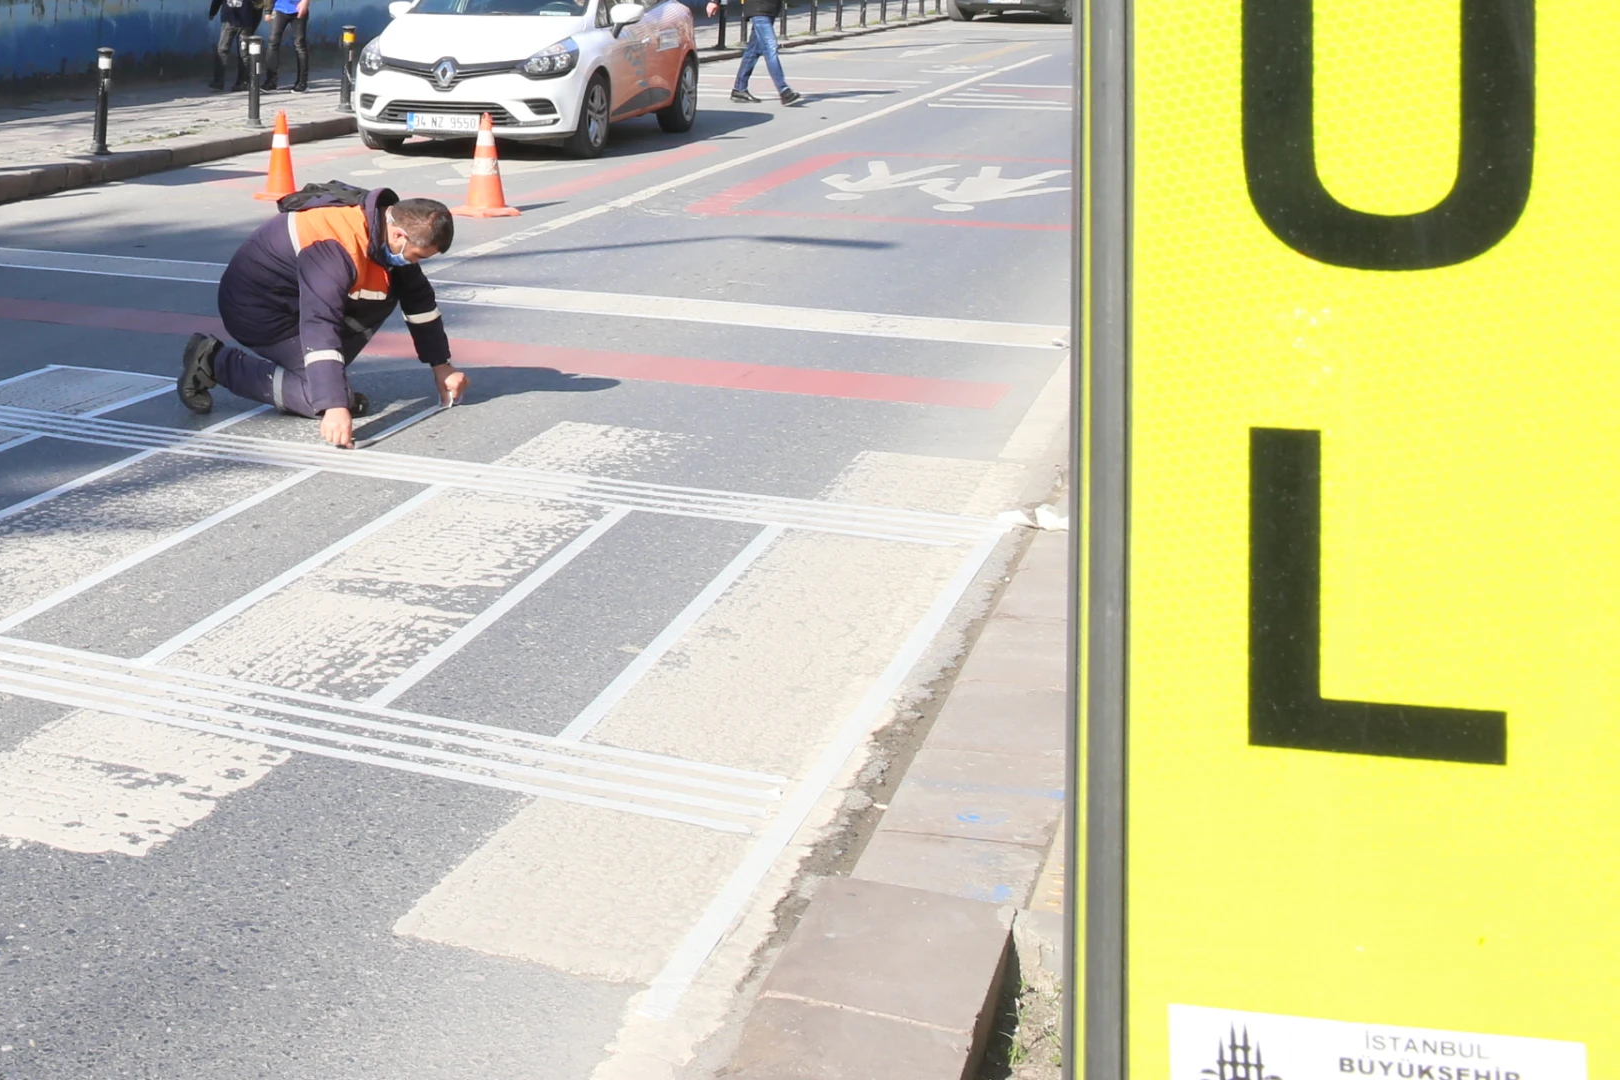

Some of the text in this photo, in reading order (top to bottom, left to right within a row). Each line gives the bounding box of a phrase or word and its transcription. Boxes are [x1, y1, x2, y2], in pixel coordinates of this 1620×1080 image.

[415, 115, 426, 128] 34
[431, 116, 444, 129] NZ
[1364, 1029, 1491, 1060] İSTANBUL
